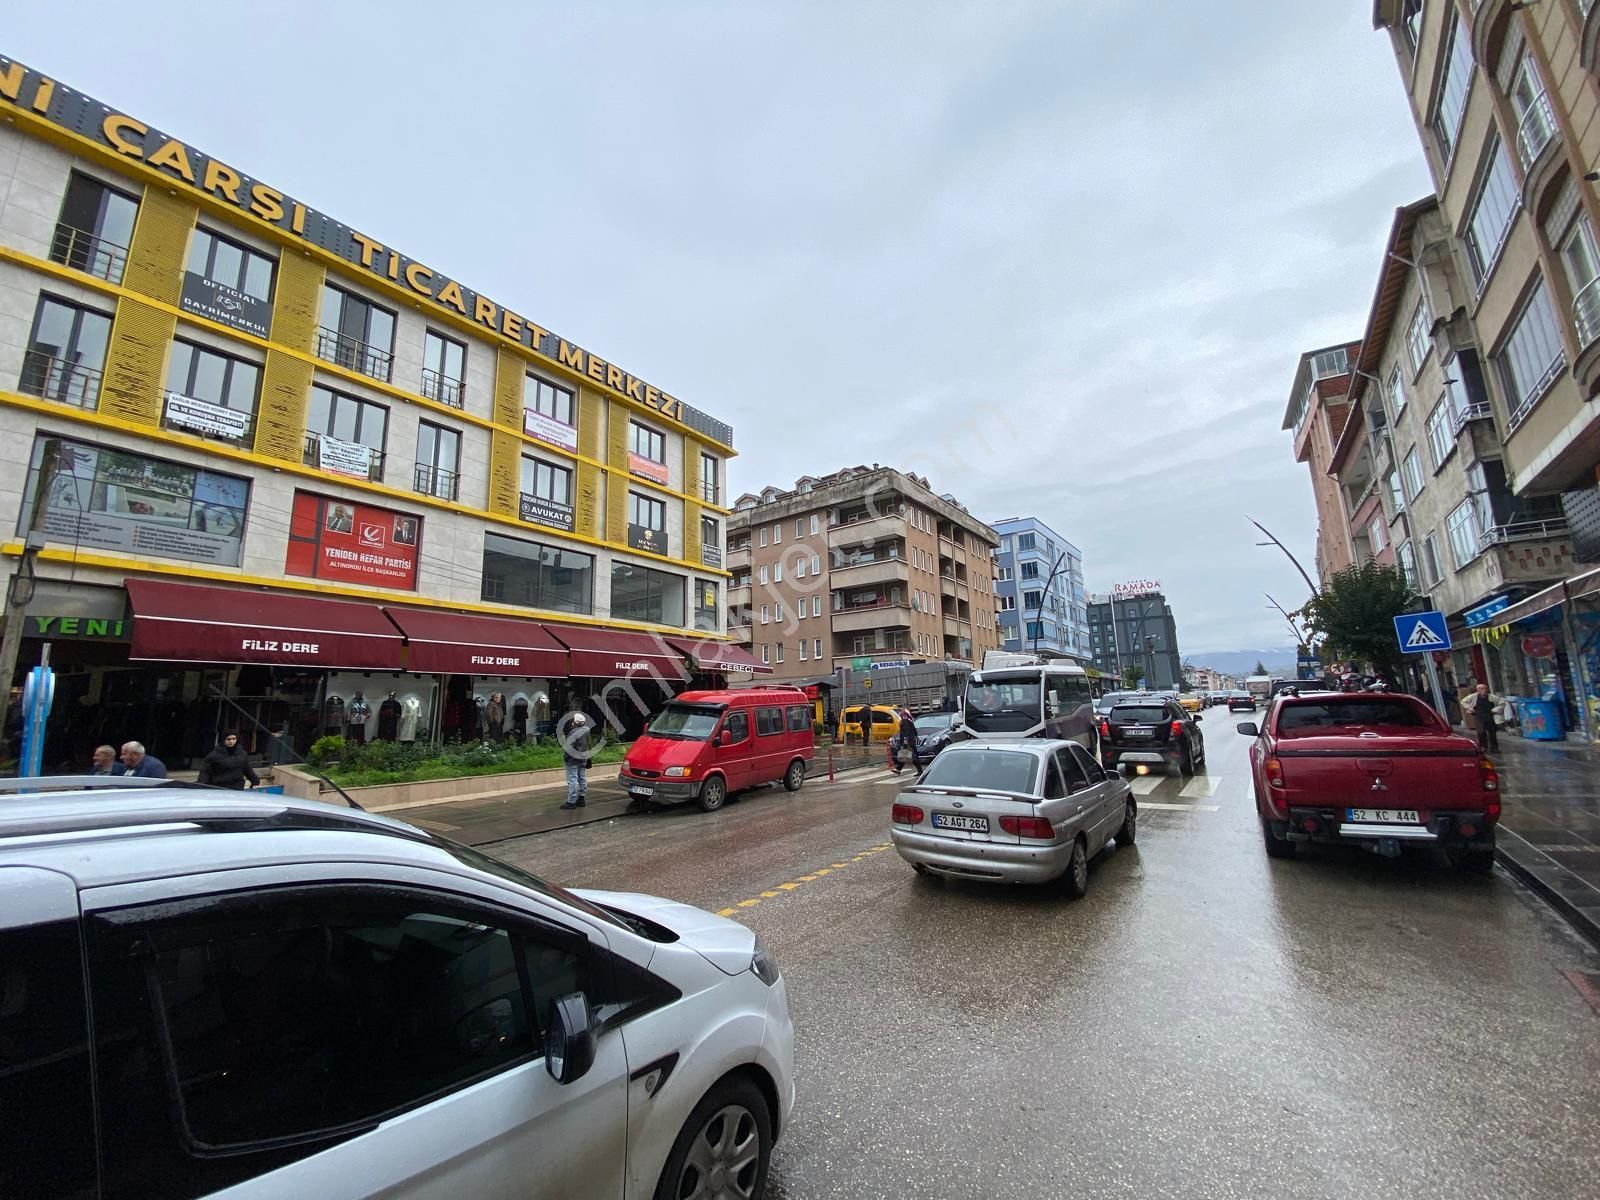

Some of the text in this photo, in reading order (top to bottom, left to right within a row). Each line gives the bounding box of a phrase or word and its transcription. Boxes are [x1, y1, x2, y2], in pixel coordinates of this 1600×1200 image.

[103, 114, 305, 234] ÇARŞI
[203, 279, 257, 306] OFFICIAL
[531, 507, 564, 520] AVUKAT
[325, 547, 358, 560] YENİDEN
[360, 553, 383, 565] REFAH
[329, 561, 361, 571] ALTINORDU
[1114, 580, 1160, 592] RAMADA
[282, 642, 319, 653] DERE
[496, 657, 520, 666] DERE
[632, 662, 649, 670] DERE
[1353, 810, 1416, 821] 52 KC 444
[937, 815, 986, 829] 52 AGT 264
